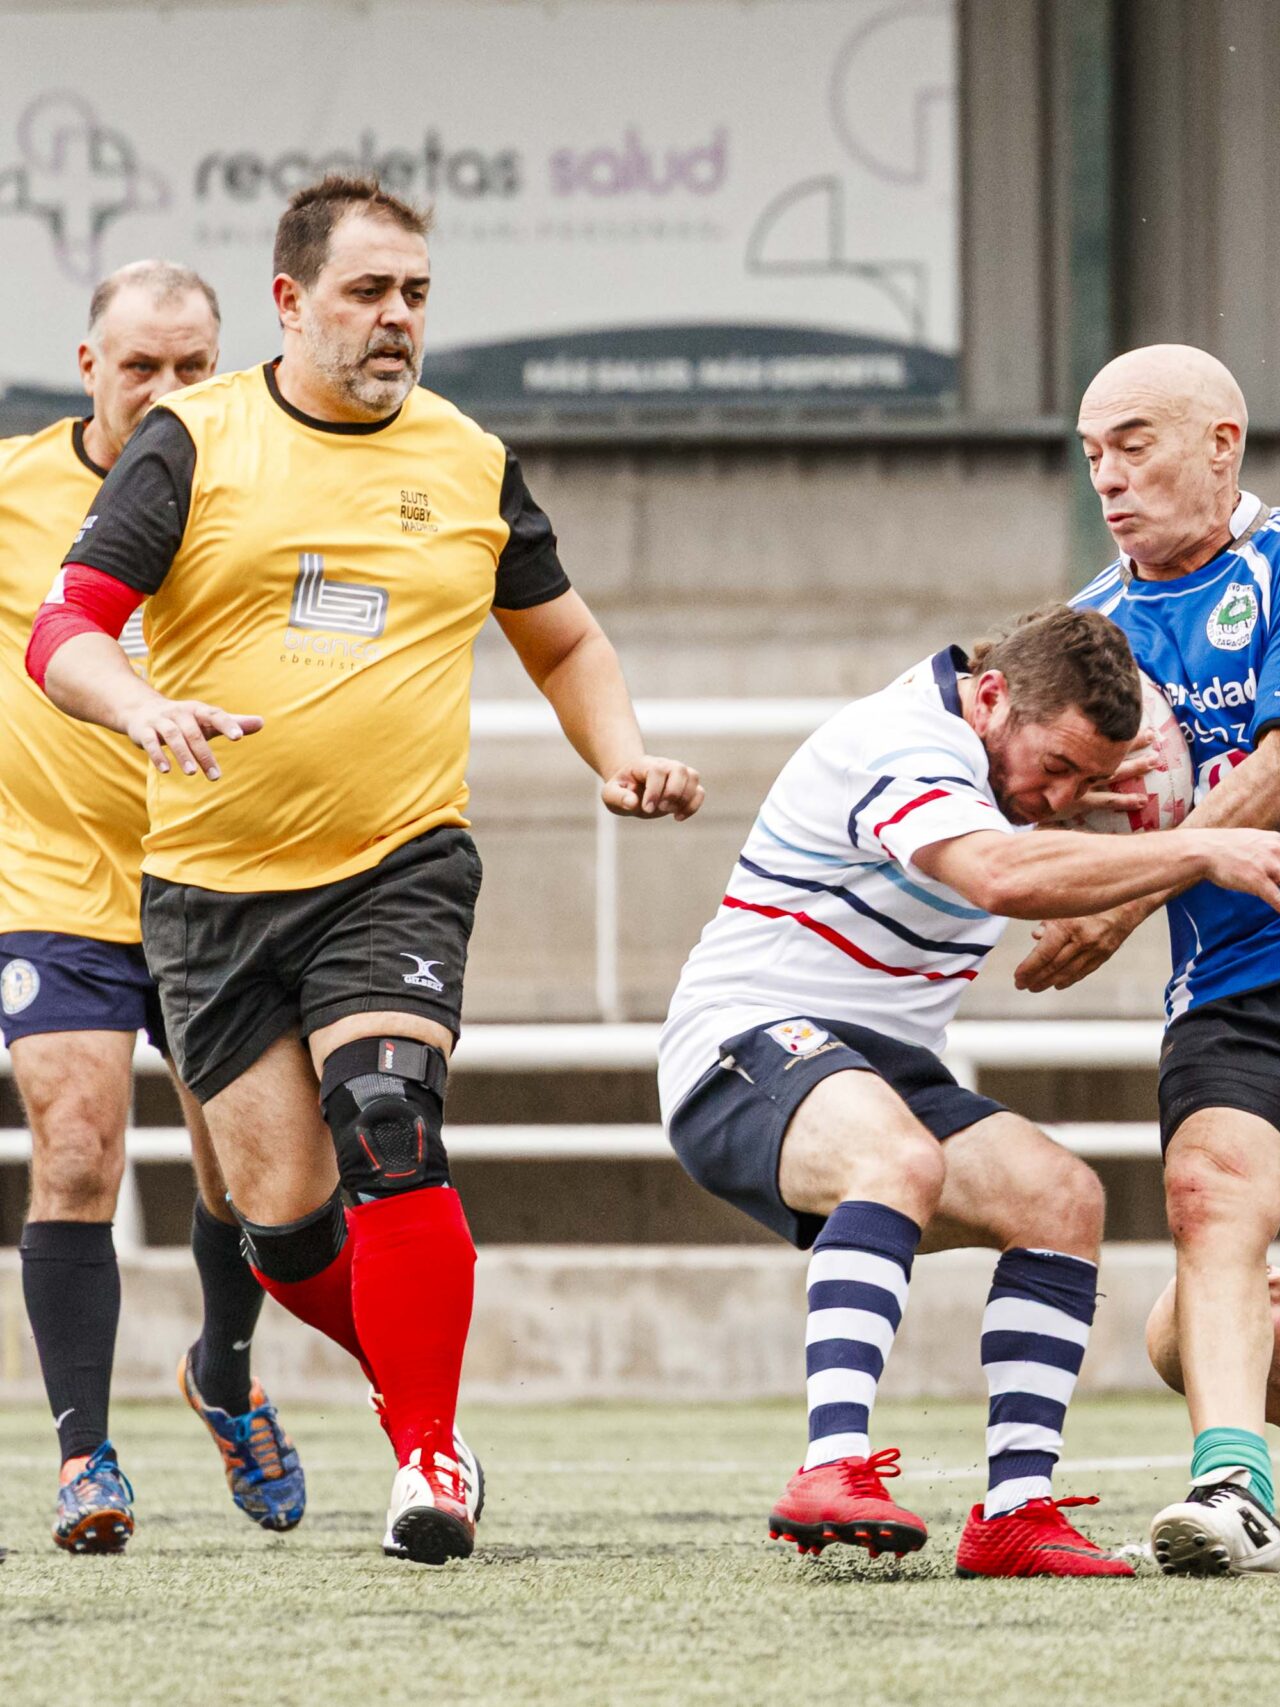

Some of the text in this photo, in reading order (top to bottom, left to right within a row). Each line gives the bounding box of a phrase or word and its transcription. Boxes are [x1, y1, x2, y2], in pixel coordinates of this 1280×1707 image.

[549, 127, 728, 198] salud
[400, 490, 428, 507] SLUTS
[400, 505, 431, 522] RUGBY
